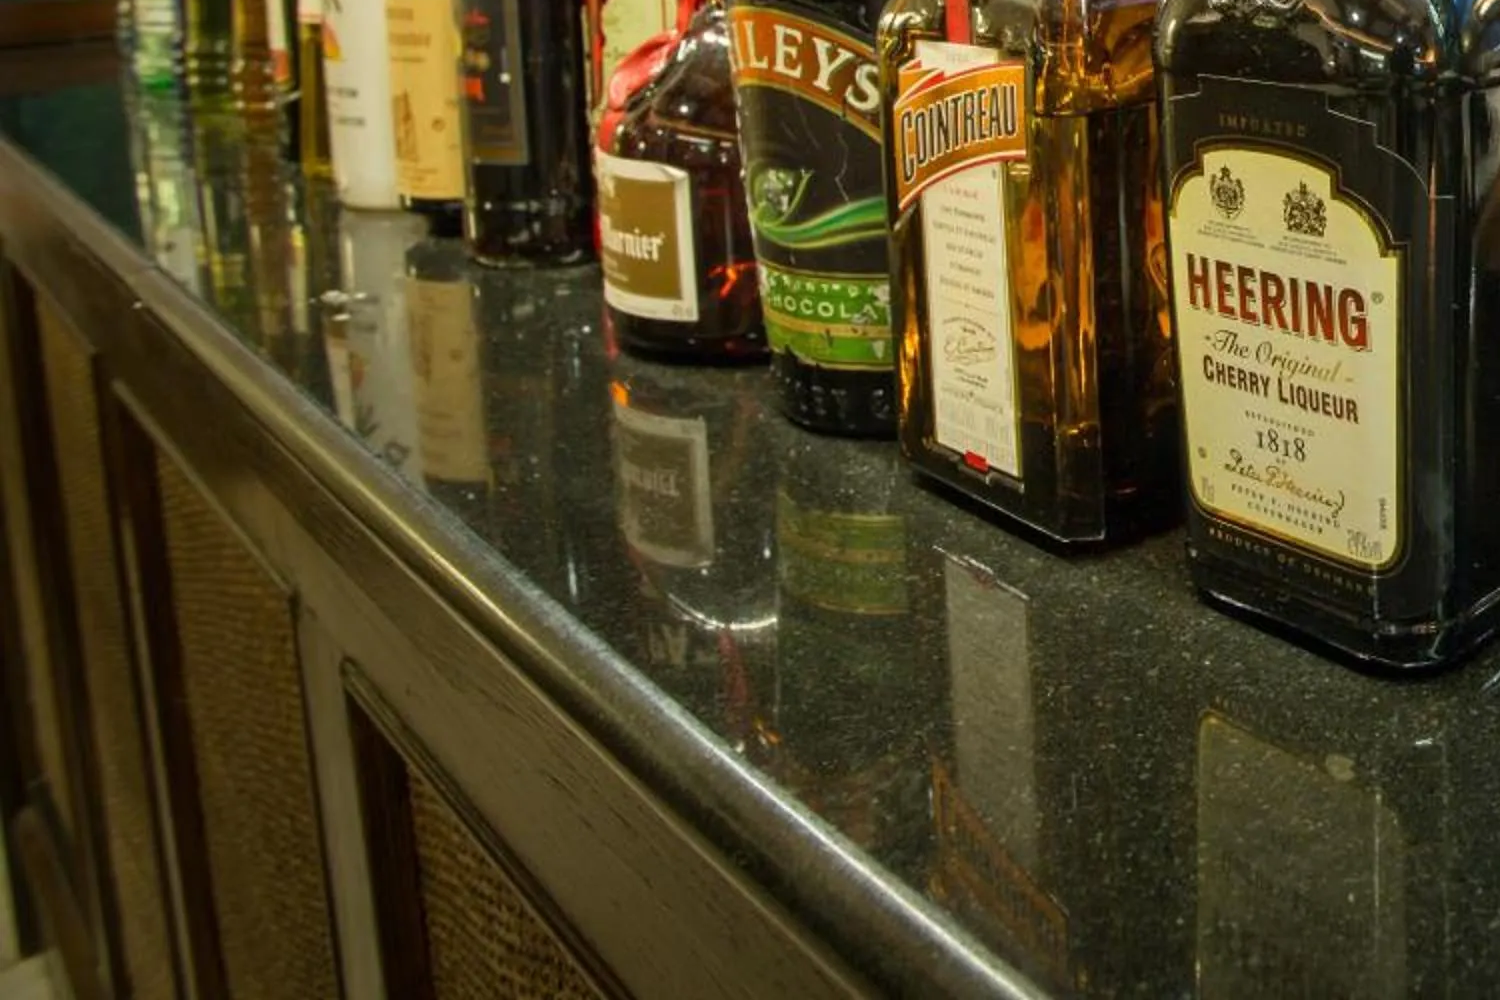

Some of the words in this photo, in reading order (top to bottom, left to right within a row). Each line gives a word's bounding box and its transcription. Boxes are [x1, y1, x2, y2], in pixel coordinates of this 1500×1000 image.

[901, 83, 1018, 184] COINTREAU
[1186, 253, 1371, 350] HEERING
[1203, 354, 1271, 399] CHERRY
[1277, 375, 1360, 425] LIQUEUR
[1208, 328, 1250, 359] The
[1255, 340, 1343, 382] Original
[1256, 427, 1307, 463] 1818
